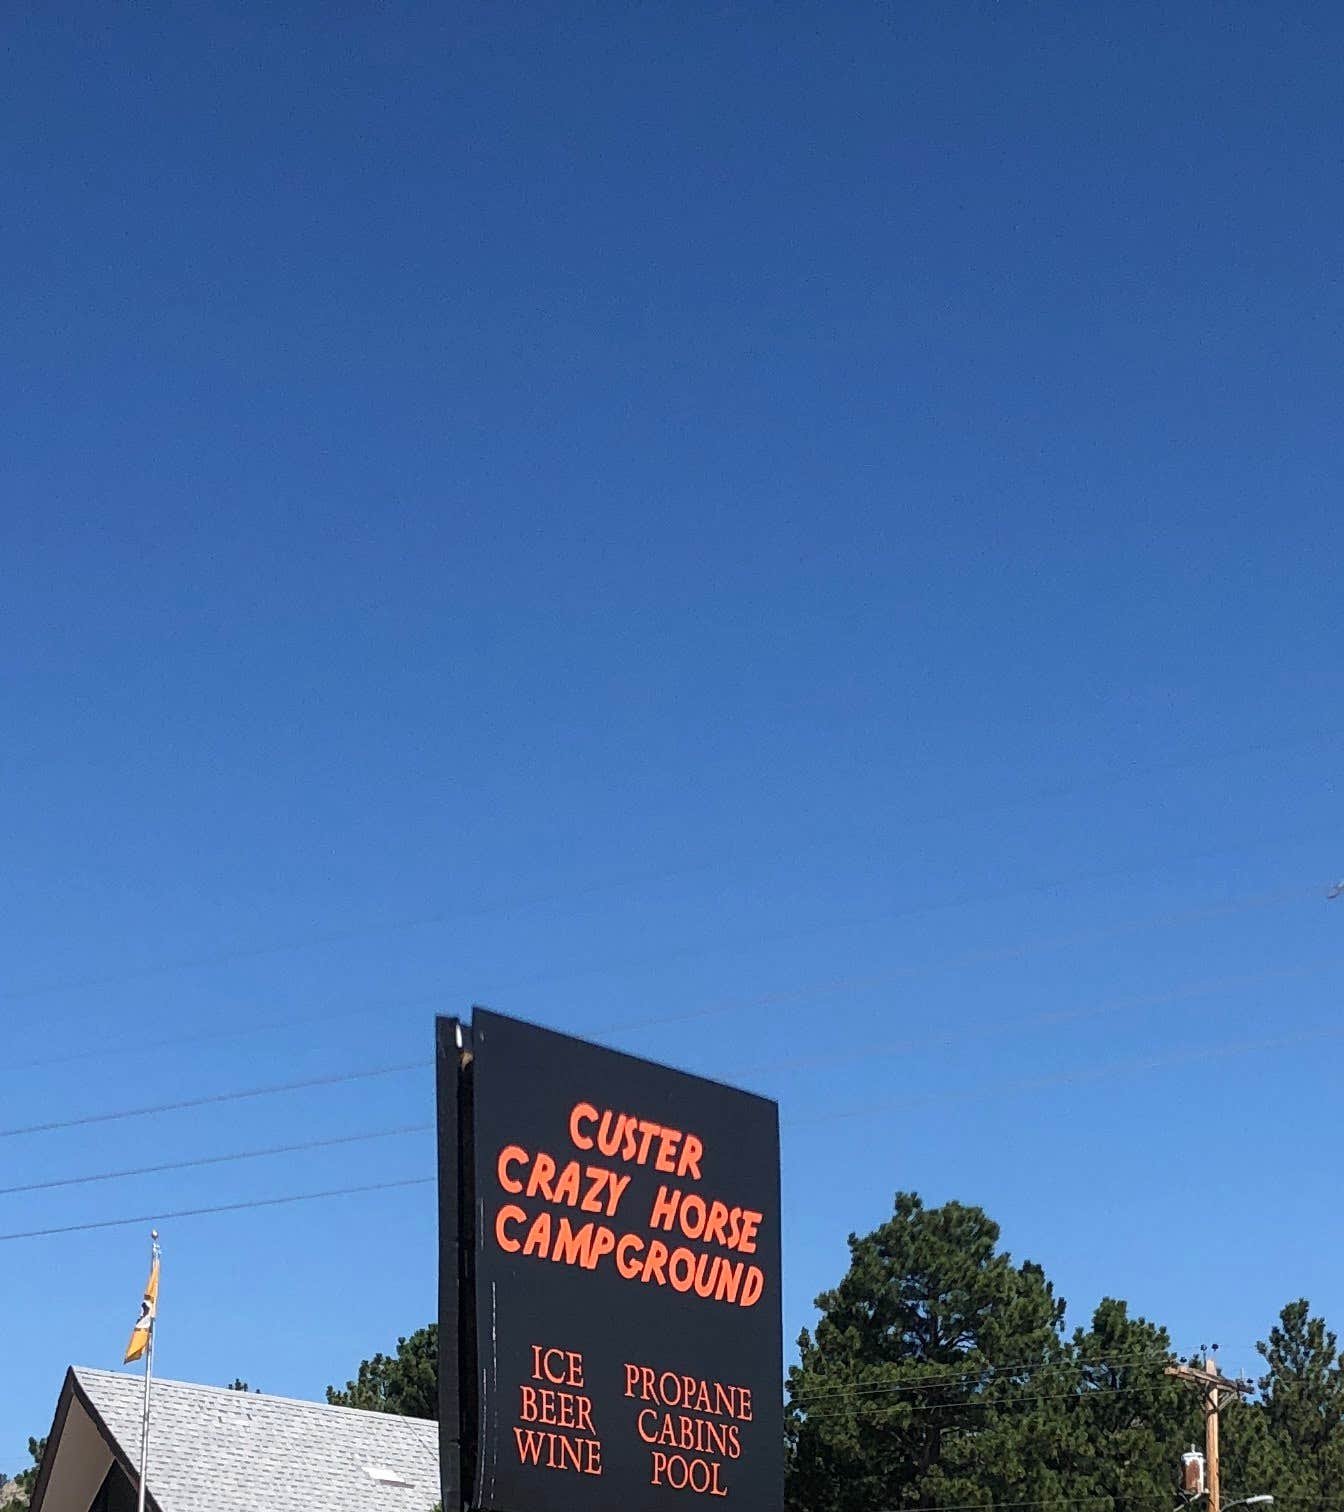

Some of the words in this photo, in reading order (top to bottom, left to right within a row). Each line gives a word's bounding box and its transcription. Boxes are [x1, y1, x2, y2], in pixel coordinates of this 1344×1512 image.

[569, 1102, 703, 1179] CUSTER
[497, 1145, 630, 1217] CRAZY
[649, 1185, 762, 1253] HORSE
[495, 1204, 764, 1307] CAMPGROUND
[532, 1345, 584, 1388] ICE
[520, 1385, 596, 1434] BEER
[624, 1364, 752, 1421] PROPANE
[513, 1427, 602, 1475] WINE
[637, 1408, 741, 1458] CABINS
[652, 1452, 728, 1496] POOL
